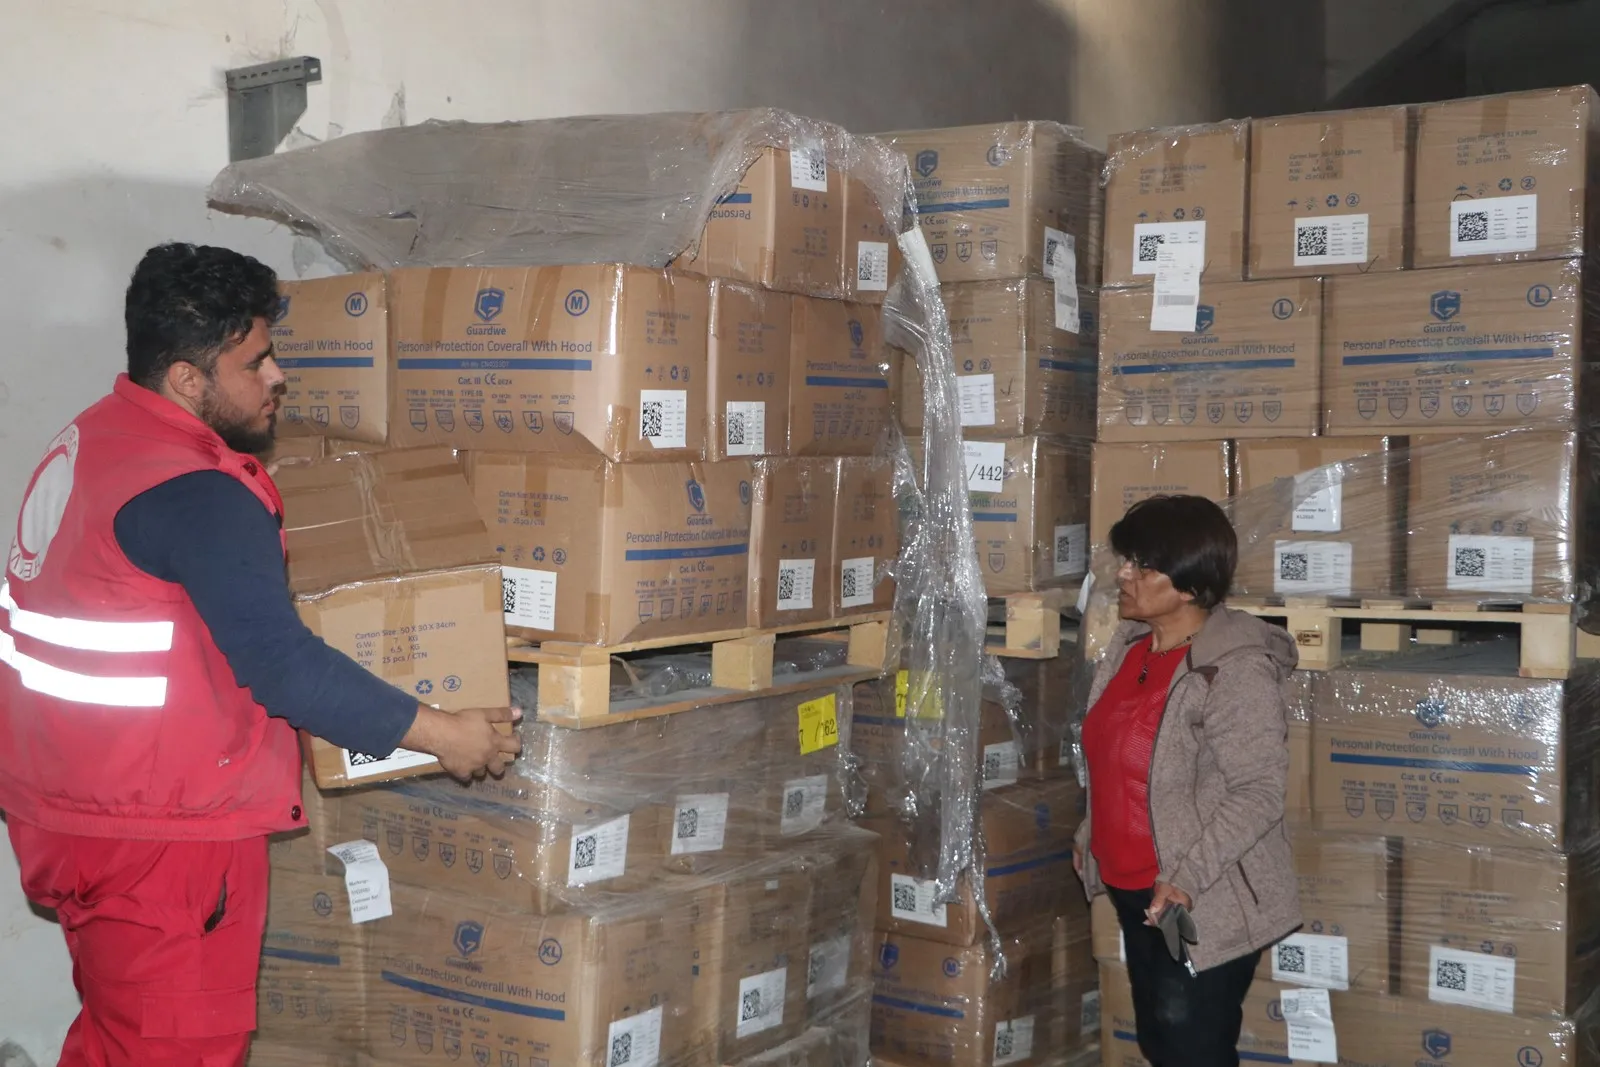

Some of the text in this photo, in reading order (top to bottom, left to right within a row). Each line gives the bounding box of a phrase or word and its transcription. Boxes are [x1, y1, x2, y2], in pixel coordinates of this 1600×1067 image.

[710, 209, 751, 220] Persona
[571, 294, 584, 310] M
[1534, 288, 1545, 303] L
[350, 298, 362, 311] M
[270, 328, 294, 337] rdwe
[466, 326, 507, 336] Guardwe
[1423, 324, 1466, 334] Guardwe
[277, 339, 373, 352] Coverall With Hood
[397, 339, 592, 353] Personal Protection Coverall With Hood
[1181, 335, 1219, 345] Guardwe
[1343, 340, 1386, 351] Personal
[1389, 337, 1443, 349] Protection
[1446, 335, 1490, 347] Coverall
[1493, 333, 1520, 345] With
[1152, 349, 1199, 360] Protection
[1202, 347, 1240, 357] Coverall
[1242, 345, 1267, 355] With
[1269, 343, 1295, 353] Hood
[968, 463, 1003, 481] /442
[993, 498, 1017, 508] Hood
[687, 516, 713, 526] Guardwe
[626, 531, 663, 543] Personal
[664, 531, 700, 542] Protection
[355, 630, 380, 640] Carton
[382, 629, 399, 638] Size:
[400, 626, 410, 634] 50
[436, 621, 456, 630] 34cm
[408, 634, 419, 643] KG
[390, 646, 402, 654] 6.5
[410, 643, 420, 651] KG
[382, 656, 391, 664] 25
[393, 655, 406, 666] pcs
[411, 651, 428, 660] CTN
[1409, 731, 1451, 741] Guardwe
[1330, 738, 1539, 760] Personal Protection Coverall With Hood
[540, 944, 560, 958] XL
[415, 963, 463, 985] Protection
[465, 975, 504, 993] Coverall
[507, 984, 532, 999] With
[535, 988, 566, 1003] Hood
[1526, 1050, 1537, 1066] L
